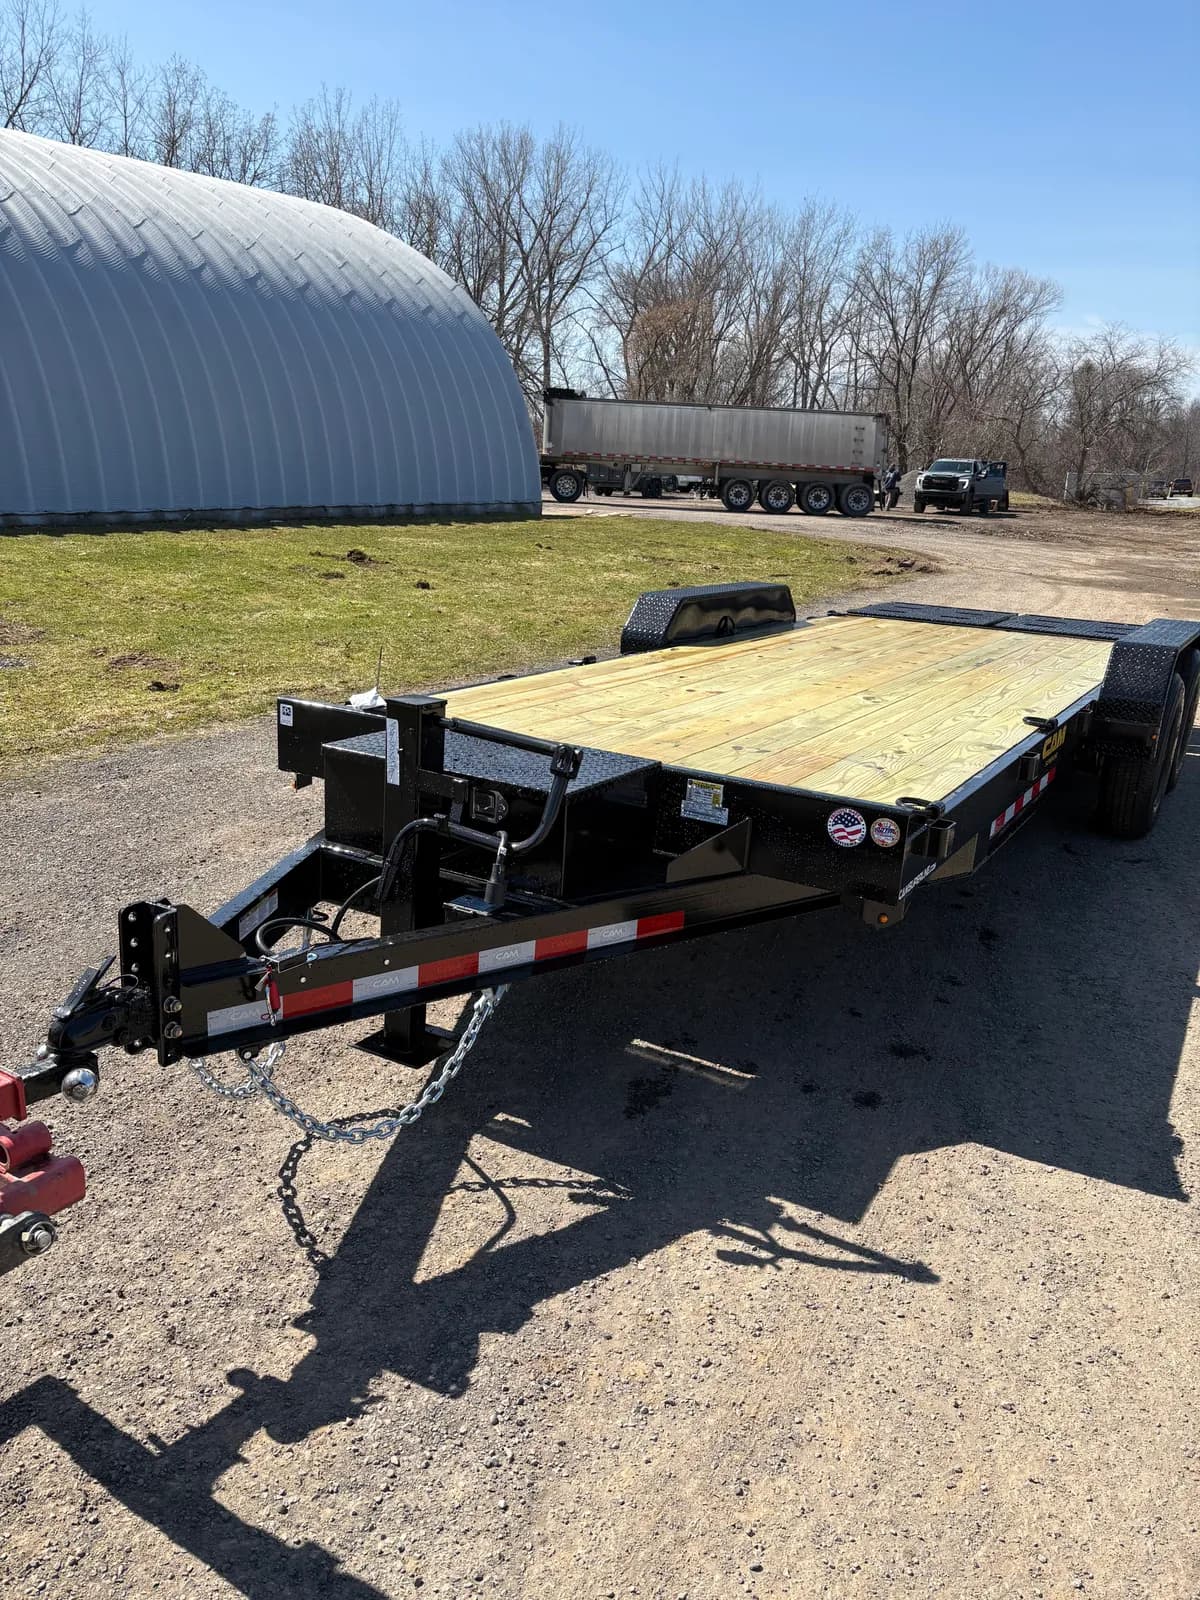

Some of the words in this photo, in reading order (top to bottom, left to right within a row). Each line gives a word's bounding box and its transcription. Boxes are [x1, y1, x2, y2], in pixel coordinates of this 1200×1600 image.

[1043, 726, 1067, 759] CAM
[602, 927, 624, 938] CAM
[495, 949, 520, 960] CAM
[372, 975, 400, 987] CAM
[230, 1008, 261, 1020] CAM
